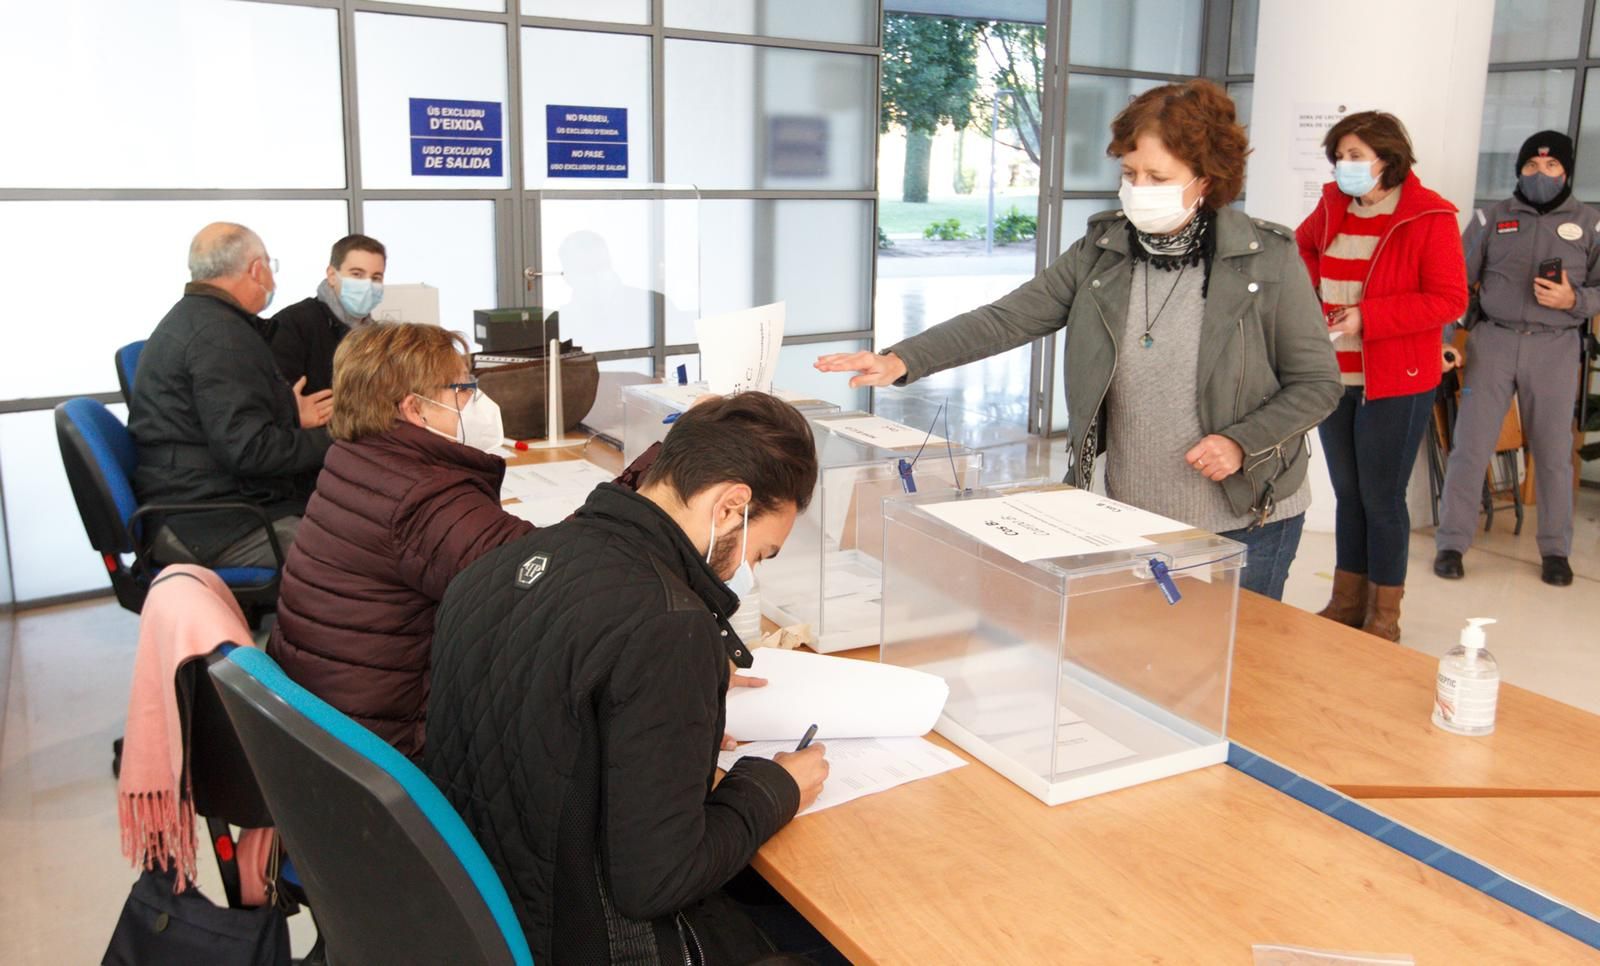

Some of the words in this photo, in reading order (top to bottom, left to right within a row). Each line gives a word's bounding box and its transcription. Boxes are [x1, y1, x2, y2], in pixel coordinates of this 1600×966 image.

[427, 105, 440, 116] ÚS
[442, 107, 486, 118] EXCLUSIU
[565, 113, 578, 122] NO
[430, 117, 484, 131] D'EIXIDA
[422, 146, 442, 155] USO
[443, 146, 493, 156] EXCLUSIVO
[571, 150, 584, 158] NO
[424, 156, 444, 168] DE
[446, 157, 491, 169] SALIDA
[550, 163, 564, 171] USO
[563, 163, 597, 171] EXCLUSIVO
[995, 526, 1019, 536] Cos
